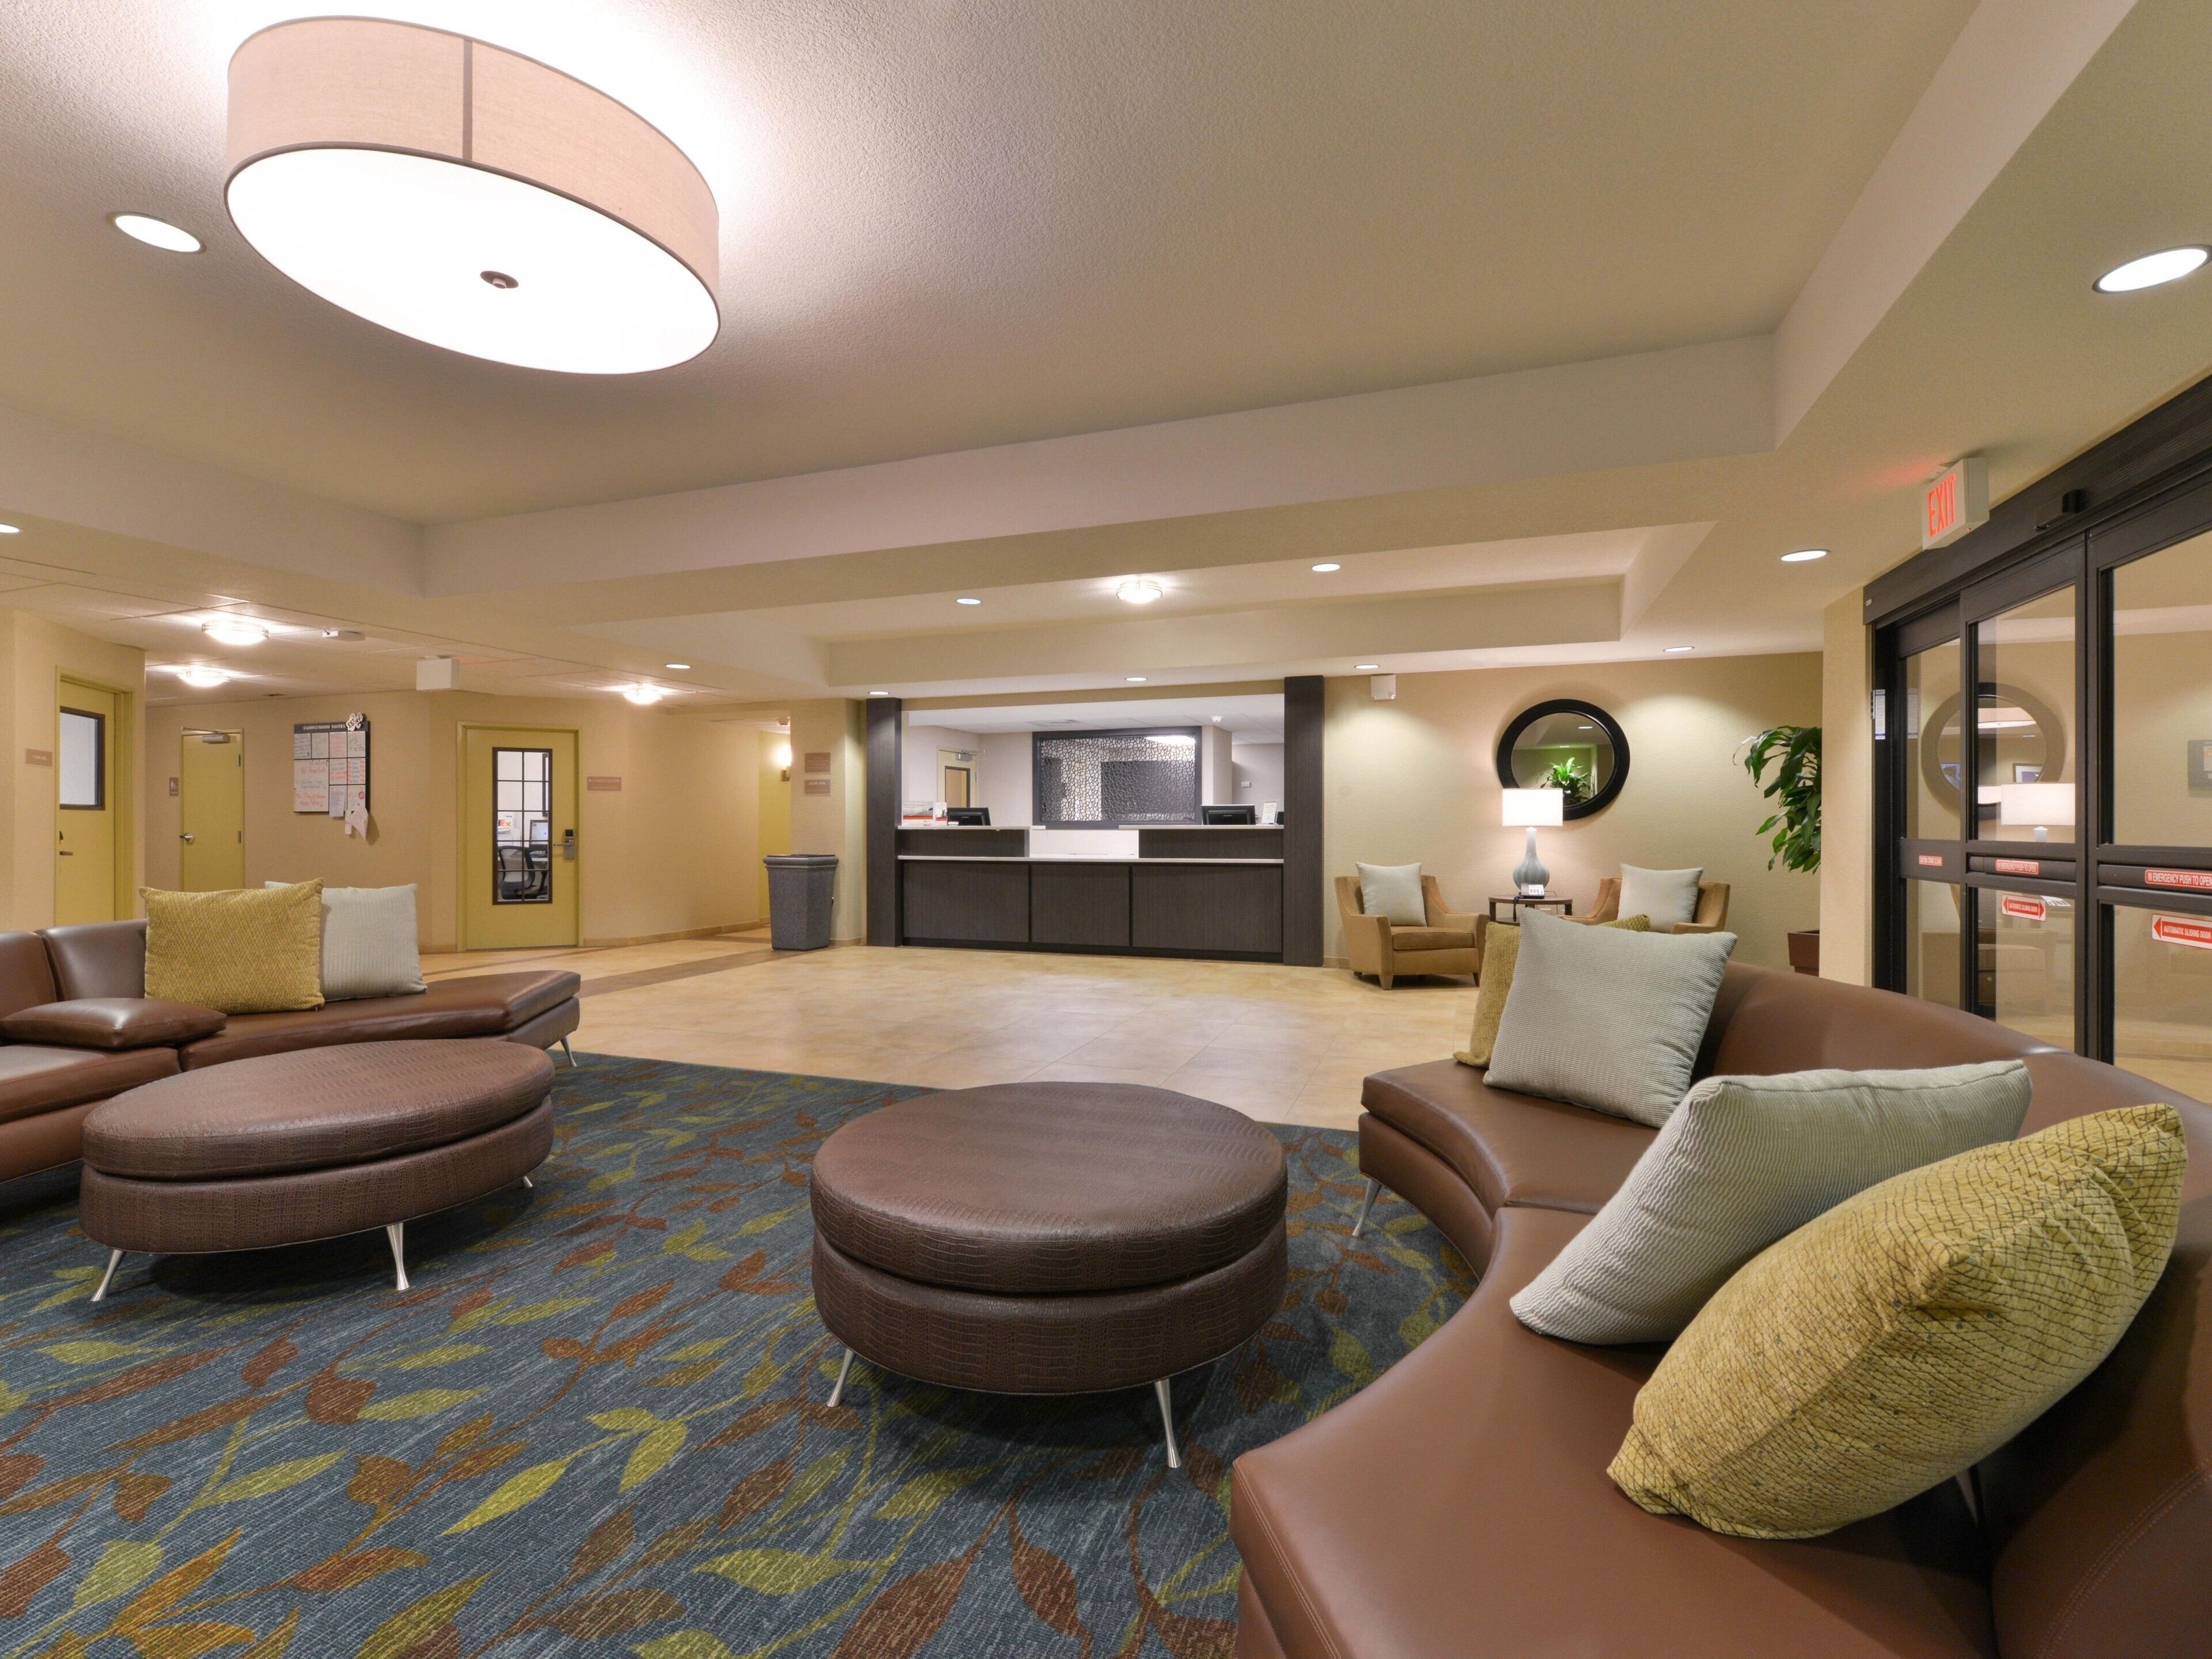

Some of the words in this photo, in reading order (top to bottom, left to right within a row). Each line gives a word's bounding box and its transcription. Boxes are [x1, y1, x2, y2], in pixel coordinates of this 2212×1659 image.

[1929, 474, 1956, 537] EXIT
[2001, 862, 2016, 870] EMERGENCY
[2028, 864, 2036, 873] OPEN
[2148, 872, 2153, 881] IN
[2153, 873, 2178, 883] EMERGENCY
[2179, 874, 2191, 884] PUSH
[2192, 875, 2199, 885] TO
[2164, 925, 2184, 935] AUTOMATIC
[2184, 928, 2199, 938] SLIDING
[2200, 930, 2211, 940] DOOR
